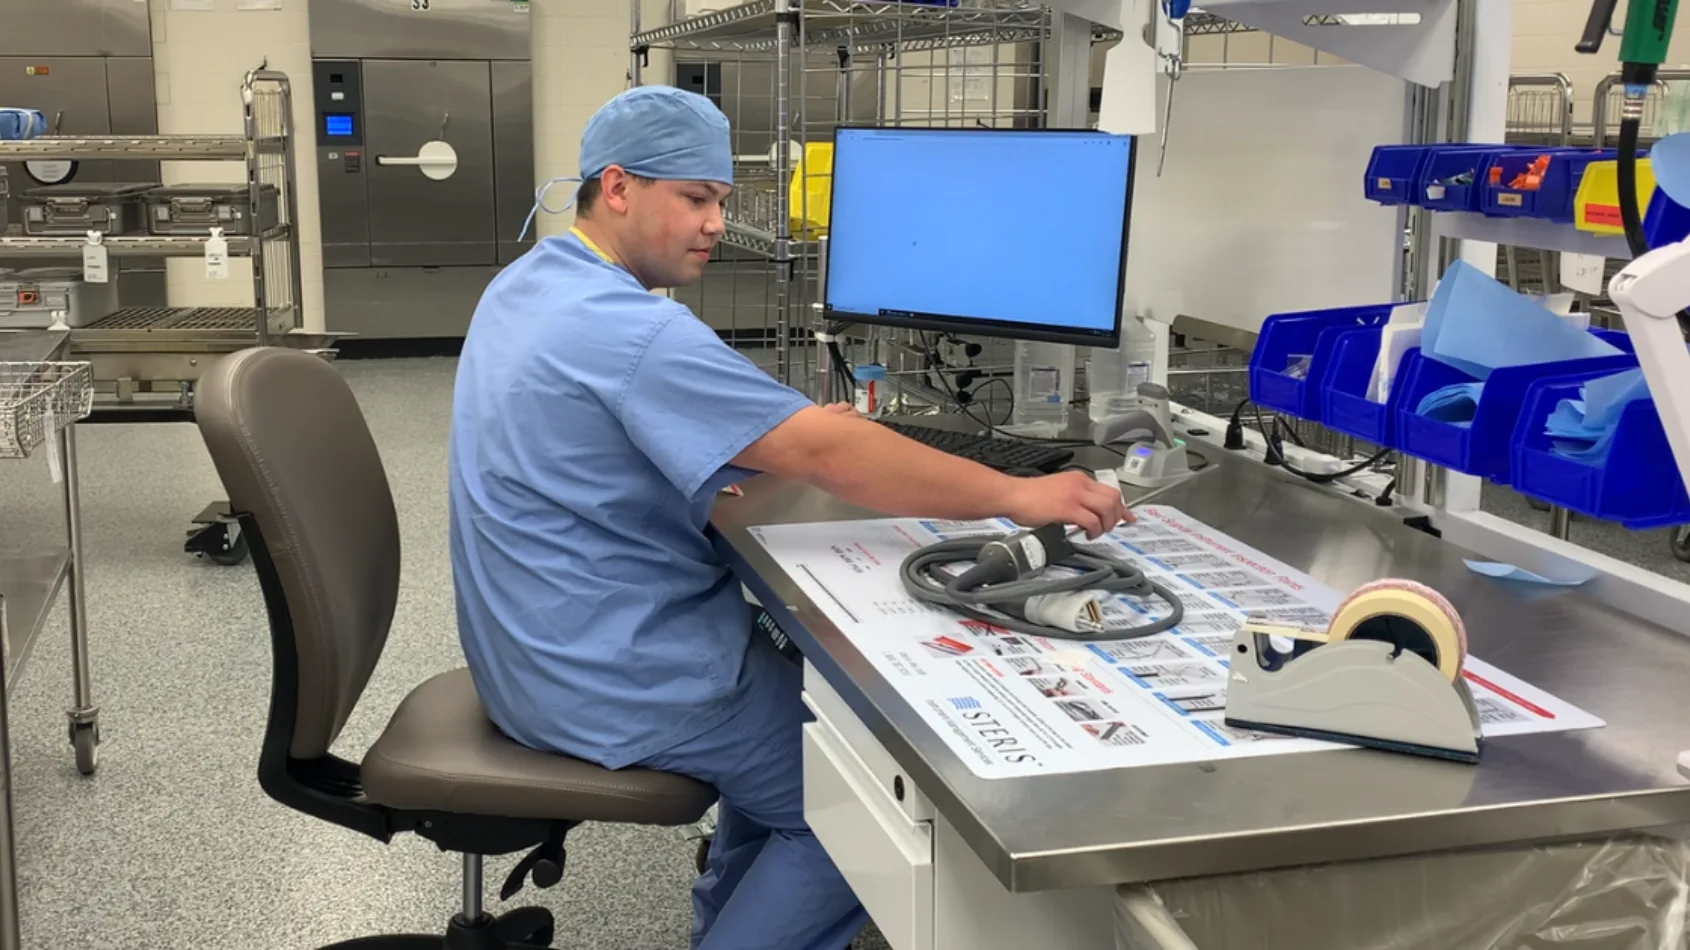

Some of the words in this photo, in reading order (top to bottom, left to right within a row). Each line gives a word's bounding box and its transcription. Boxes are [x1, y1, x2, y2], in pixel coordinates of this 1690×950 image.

[1190, 532, 1233, 554] Instrument
[1231, 553, 1276, 575] Inspection
[962, 712, 1036, 763] STERIS
